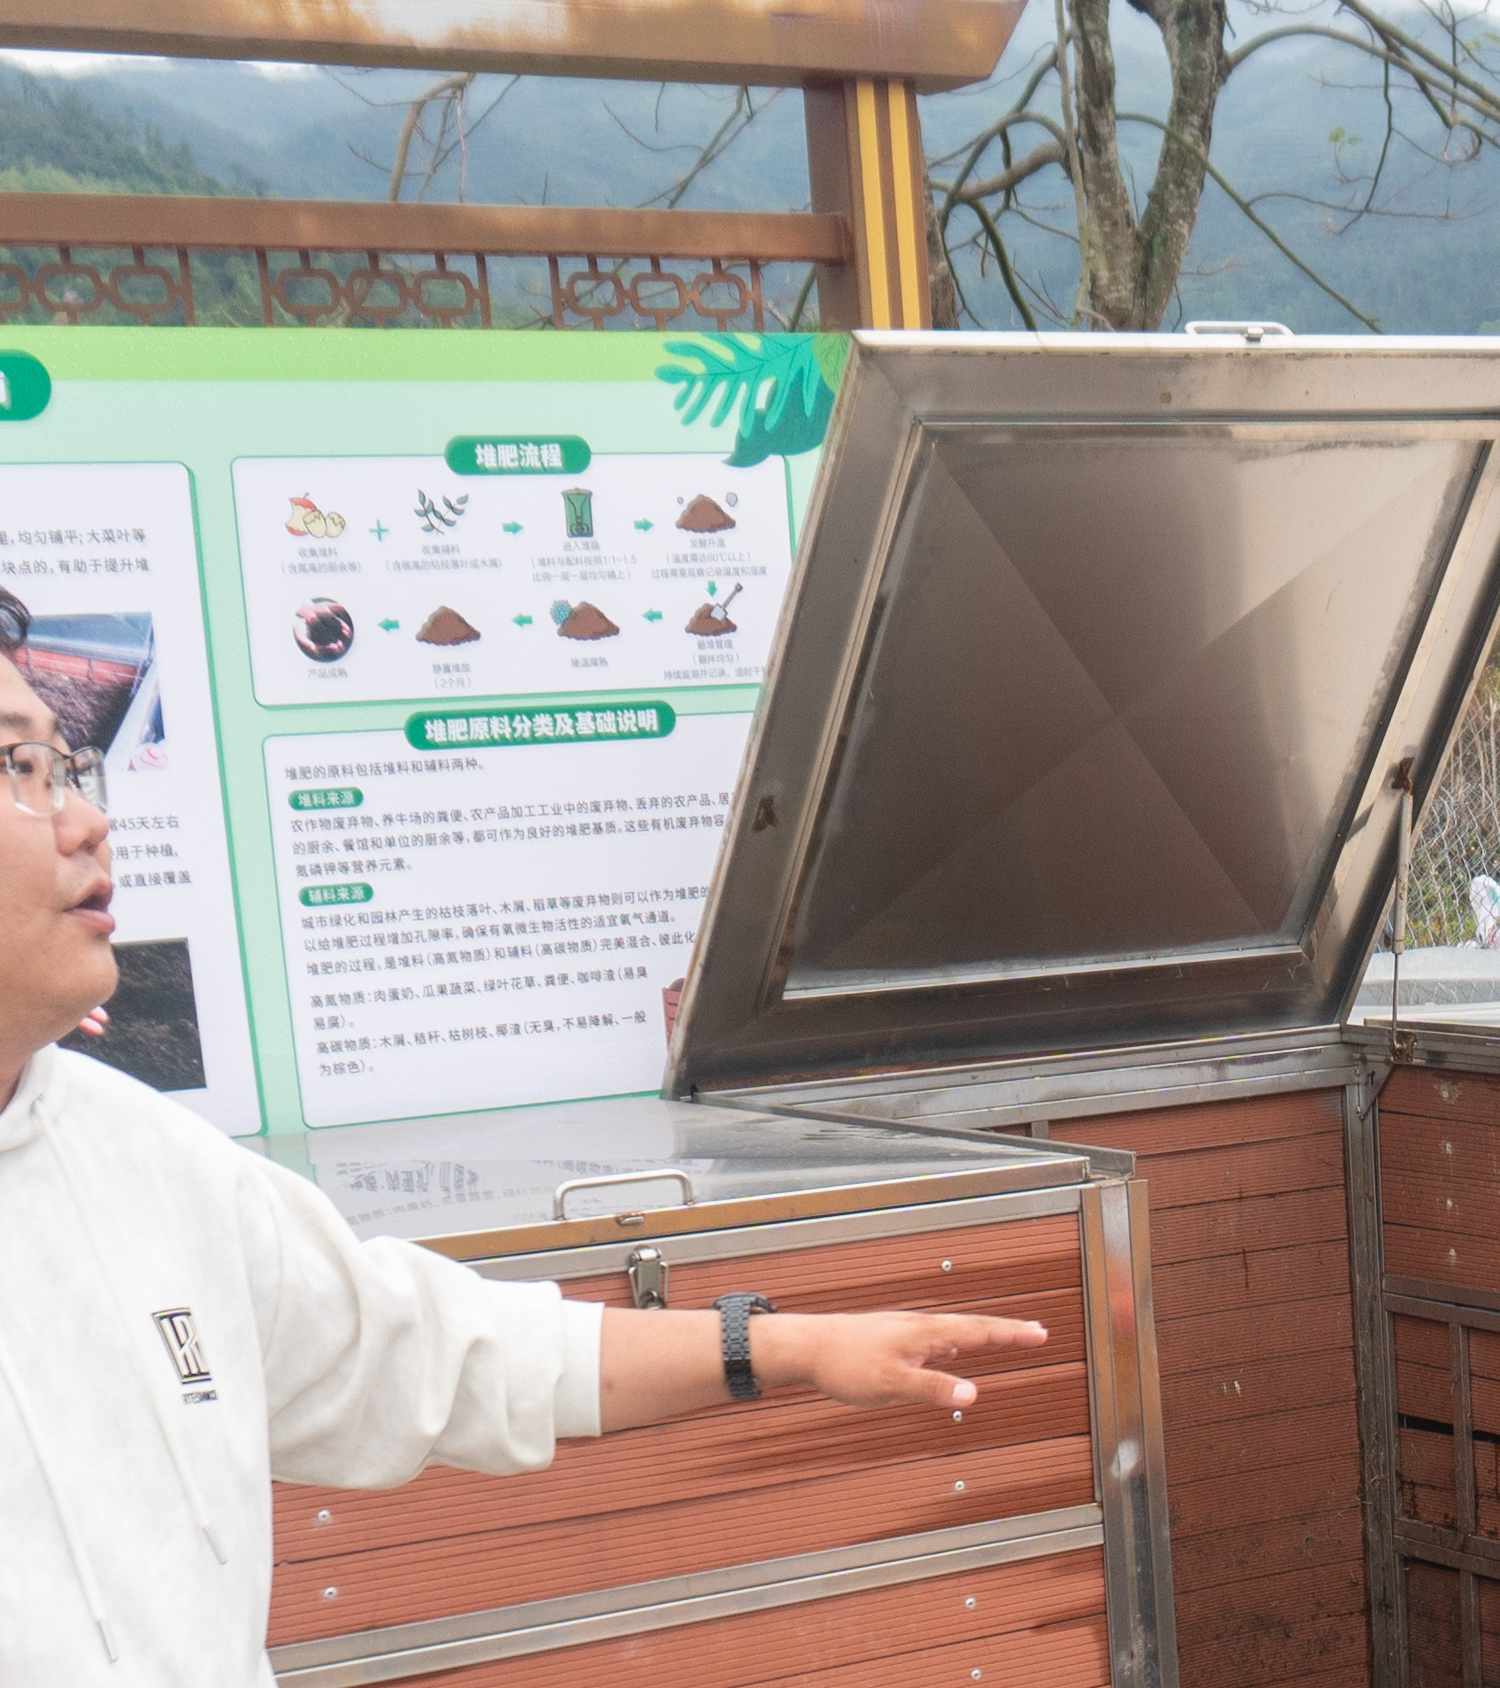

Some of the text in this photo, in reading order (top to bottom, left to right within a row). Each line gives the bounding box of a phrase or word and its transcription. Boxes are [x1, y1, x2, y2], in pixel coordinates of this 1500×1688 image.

[475, 443, 562, 469] 堆肥流程
[426, 709, 658, 743] 堆肥原料分类及基础说明
[308, 886, 365, 903] 辅料来源
